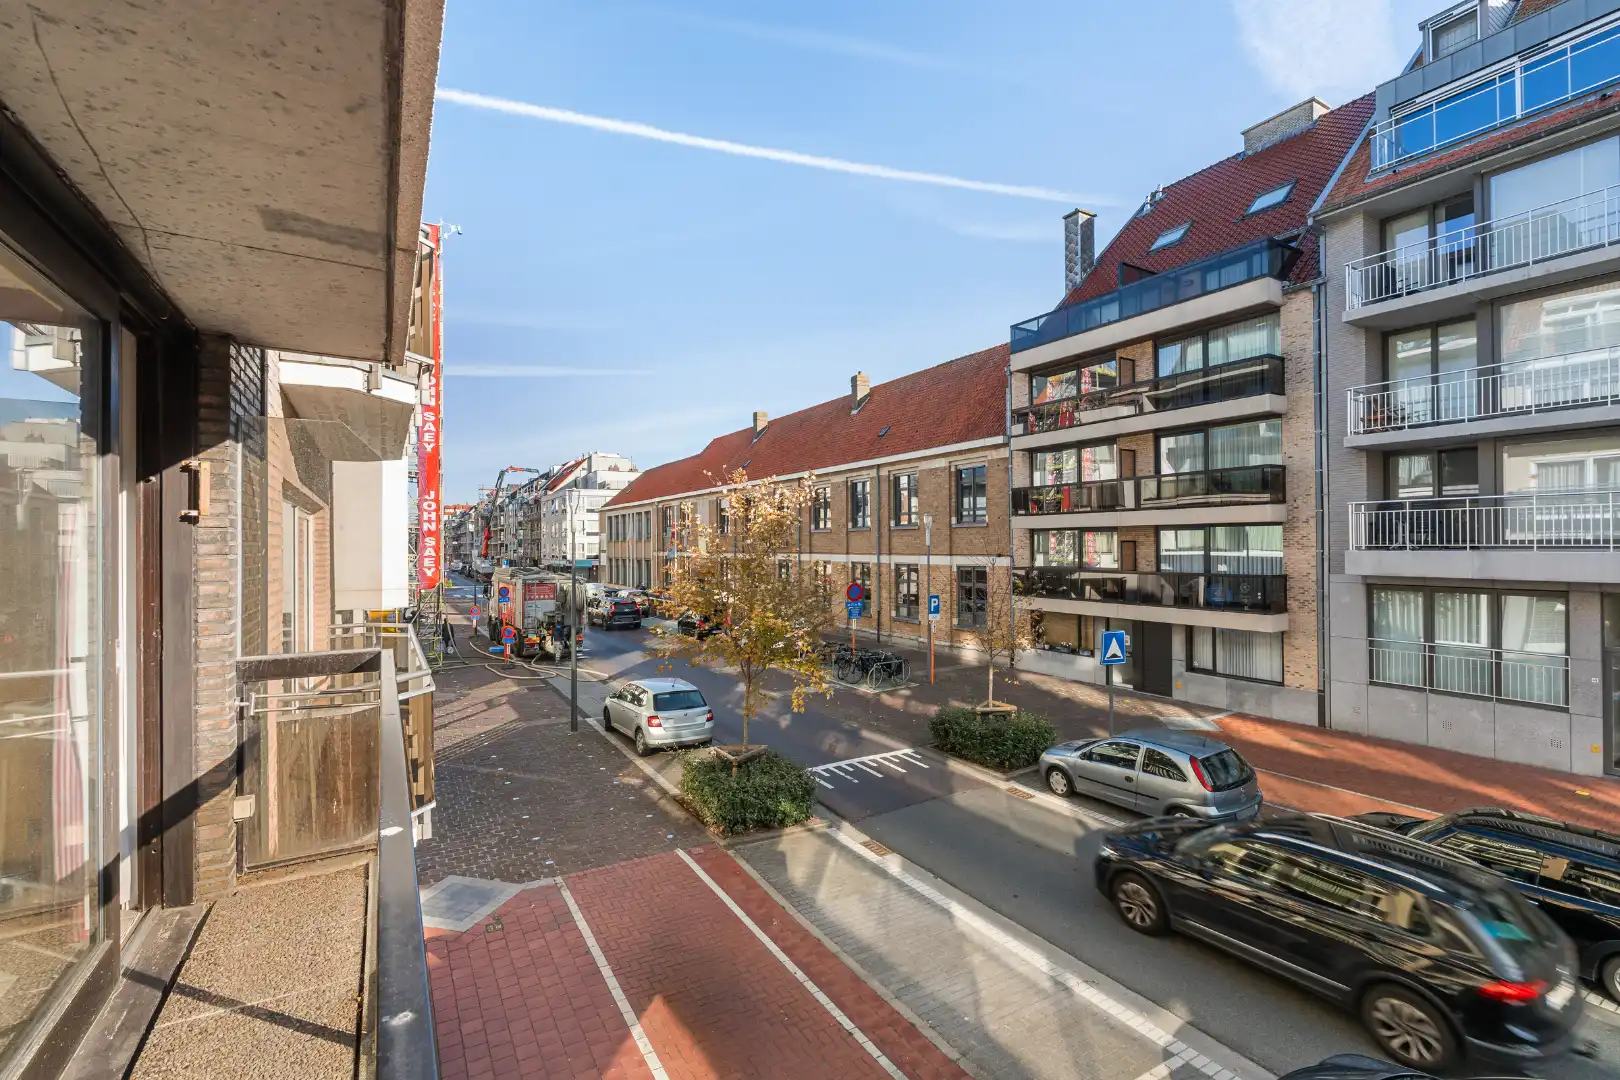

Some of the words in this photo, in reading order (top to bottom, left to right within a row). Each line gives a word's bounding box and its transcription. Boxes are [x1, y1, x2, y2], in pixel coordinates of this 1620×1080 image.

[423, 411, 436, 452] SAEY
[423, 490, 436, 531] JOHN
[423, 536, 436, 577] SAEY
[931, 598, 939, 612] P
